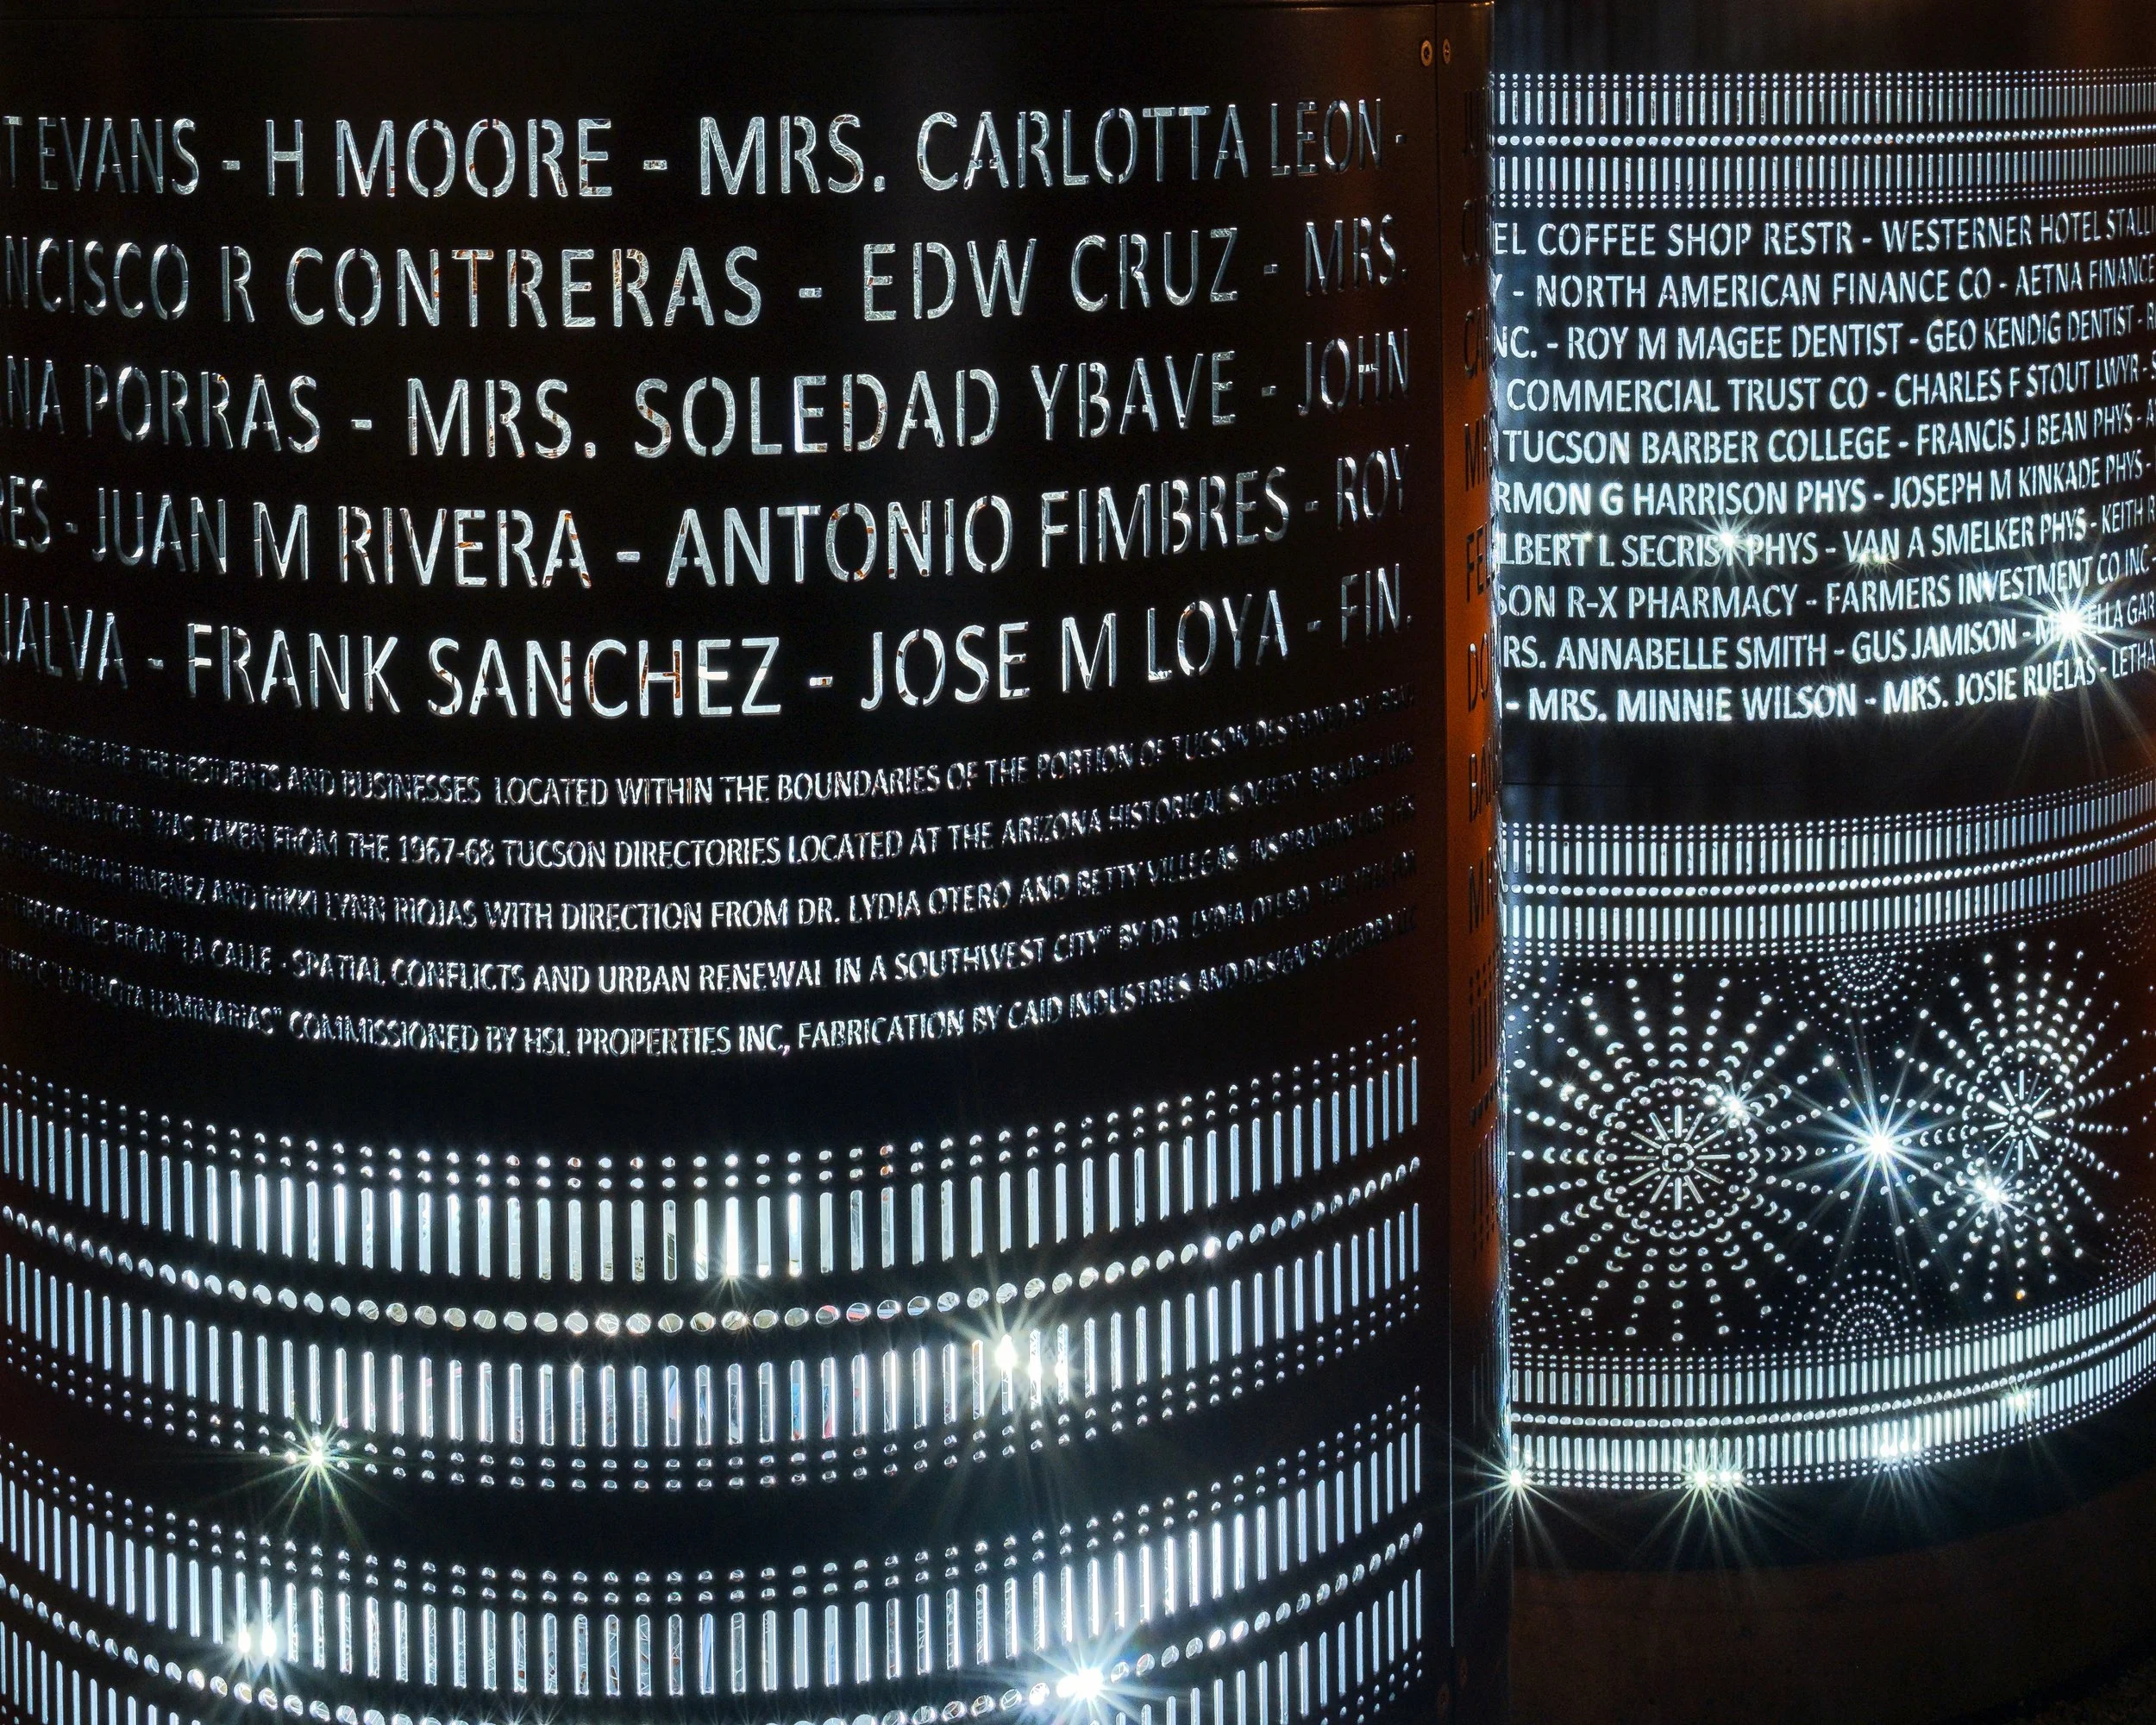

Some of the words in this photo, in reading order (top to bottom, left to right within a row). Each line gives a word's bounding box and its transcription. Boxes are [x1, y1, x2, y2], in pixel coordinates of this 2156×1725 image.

[38, 116, 199, 196] EVANS
[265, 118, 304, 198] H
[335, 118, 612, 198] MOORE
[699, 113, 887, 196] MRS.
[916, 104, 1249, 191] CARLOTTA
[1270, 98, 1382, 178] LEON
[5, 235, 190, 321] NCISCO
[221, 245, 256, 323] R
[285, 245, 762, 328] CONTRERAS
[862, 238, 1037, 323] EDW
[1069, 227, 1238, 313] CRUZ
[1304, 213, 1408, 298] MRS.
[1537, 221, 1657, 257] COFFEE
[1666, 221, 1753, 258] SHOP
[1764, 220, 1854, 258] RESTR
[1881, 212, 2033, 254] WESTERNER
[2039, 210, 2103, 247] HOTEL
[1536, 272, 1646, 309] NORTH
[1657, 272, 1822, 309] AMERICAN
[1833, 267, 1950, 306] FINANCE
[1958, 265, 1992, 302] CO
[2015, 260, 2084, 298] AETNA
[2088, 252, 2156, 291] FINANCE
[1567, 324, 1630, 361] ROY
[1639, 327, 1666, 361] M
[1677, 324, 1783, 361] MAGEE
[1791, 321, 1904, 360] DENTIST
[1926, 317, 1977, 355] GEO
[1984, 310, 2062, 350] KENDIG
[2067, 303, 2136, 343] DENTIST
[7, 354, 65, 436] NA
[84, 363, 322, 455] PORRAS
[407, 377, 597, 460] MRS.
[634, 369, 1000, 459] SOLEDAD
[1030, 349, 1237, 441] YBAVE
[1297, 328, 1411, 417] JOHN
[1507, 377, 1720, 413] COMMERCIAL
[1727, 376, 1822, 413] TRUST
[1828, 374, 1870, 411] CO
[1895, 367, 2003, 408] CHARLES
[2009, 366, 2021, 400] F
[2026, 358, 2091, 399] STOUT
[2095, 352, 2140, 390] LWYR
[1501, 429, 1632, 465] TUCSON
[1640, 430, 1760, 465] BARBER
[1767, 423, 1893, 464] COLLEGE
[1915, 416, 2015, 458] FRANCIS
[2020, 415, 2030, 449] J
[2036, 408, 2090, 448] BEAN
[2092, 400, 2134, 440] PHYS
[92, 486, 228, 575] JUAN
[253, 501, 310, 581] M
[337, 506, 592, 589] RIVERA
[666, 493, 1013, 588] ANTONIO
[1041, 466, 1290, 568] FIMBRES
[1335, 443, 1411, 530] ROY
[1599, 480, 1626, 518] G
[1633, 480, 1789, 518] HARRISON
[1796, 475, 1868, 515] PHYS
[1889, 469, 1984, 511] JOSEPH
[1990, 467, 2012, 502] M
[2017, 455, 2101, 499] KINKADE
[2104, 448, 2144, 486] PHYS
[1598, 530, 1616, 568] L
[1745, 530, 1820, 568] PHYS
[1841, 526, 1901, 564] VAN
[1907, 524, 1926, 560] A
[1930, 512, 2034, 558] SMELKER
[2039, 506, 2089, 547] PHYS
[2100, 493, 2145, 536] KEITH
[1566, 584, 1619, 619] R-X
[1627, 582, 1799, 620] PHARMACY
[1825, 572, 1952, 616] FARMERS
[1957, 554, 2094, 605] INVESTMENT
[2096, 550, 2121, 586] CO
[2124, 543, 2151, 580] INC
[185, 622, 402, 715] FRANK
[428, 636, 783, 718] SANCHEZ
[860, 620, 1031, 712] JOSE
[1061, 612, 1118, 693] M
[1147, 589, 1290, 682] LOYA
[1340, 562, 1413, 649] FIN.
[1502, 635, 1547, 670] RS.
[1554, 636, 1729, 671] ANNABELLE
[1734, 631, 1827, 671] SMITH
[1852, 627, 1908, 667] GUS
[1909, 616, 2018, 662] JAMISON
[1526, 686, 1608, 724] MRS.
[1616, 687, 1733, 724] MINNIE
[1740, 682, 1857, 721] WILSON
[1881, 674, 1951, 718] MRS.
[1953, 665, 2019, 709] JOSIE
[2022, 653, 2097, 700] RUELAS
[2111, 637, 2156, 681] LETHA
[341, 768, 482, 805] BUSINESSES
[494, 777, 609, 806] LOCATED
[614, 775, 714, 806] WITHIN
[719, 774, 771, 805] THE
[777, 763, 941, 803] BOUNDARIES
[946, 759, 979, 791] OF
[984, 755, 1031, 787] THE
[1037, 742, 1134, 781] PORTION
[272, 824, 340, 857] FROM
[347, 831, 392, 863] THE
[398, 833, 496, 868] 1967-68
[500, 838, 607, 869] TUCSON
[614, 835, 781, 870] DIRECTORIES
[787, 828, 904, 864] LOCATED
[909, 825, 943, 857] AT
[948, 820, 994, 852] THE
[1001, 806, 1102, 847] ARIZONA
[1109, 786, 1225, 831] HISTORICAL
[483, 900, 554, 932] WITH
[561, 900, 703, 932] DIRECTION
[711, 897, 789, 930] FROM
[798, 895, 841, 926] DR.
[849, 888, 922, 925] LYDIA
[927, 878, 1012, 916] OTERO
[1019, 872, 1071, 906] AND
[1077, 860, 1144, 898] BETTY
[291, 948, 387, 988] SPATIAL
[390, 957, 527, 994] CONFLICTS
[533, 963, 592, 994] AND
[598, 963, 692, 994] URBAN
[834, 955, 862, 986] IN
[869, 953, 888, 984] A
[893, 936, 1047, 982] SOUTHWEST
[288, 1008, 480, 1054] COMMISSIONED
[485, 1023, 519, 1055] BY
[523, 1024, 572, 1057] HSL
[576, 1024, 733, 1058] PROPERTIES
[738, 1021, 793, 1057] INC,
[798, 1006, 966, 1051] FABRICATION
[972, 1001, 1004, 1036] BY
[1007, 994, 1064, 1032] CAID
[1069, 970, 1193, 1020] INDUSTRIES
